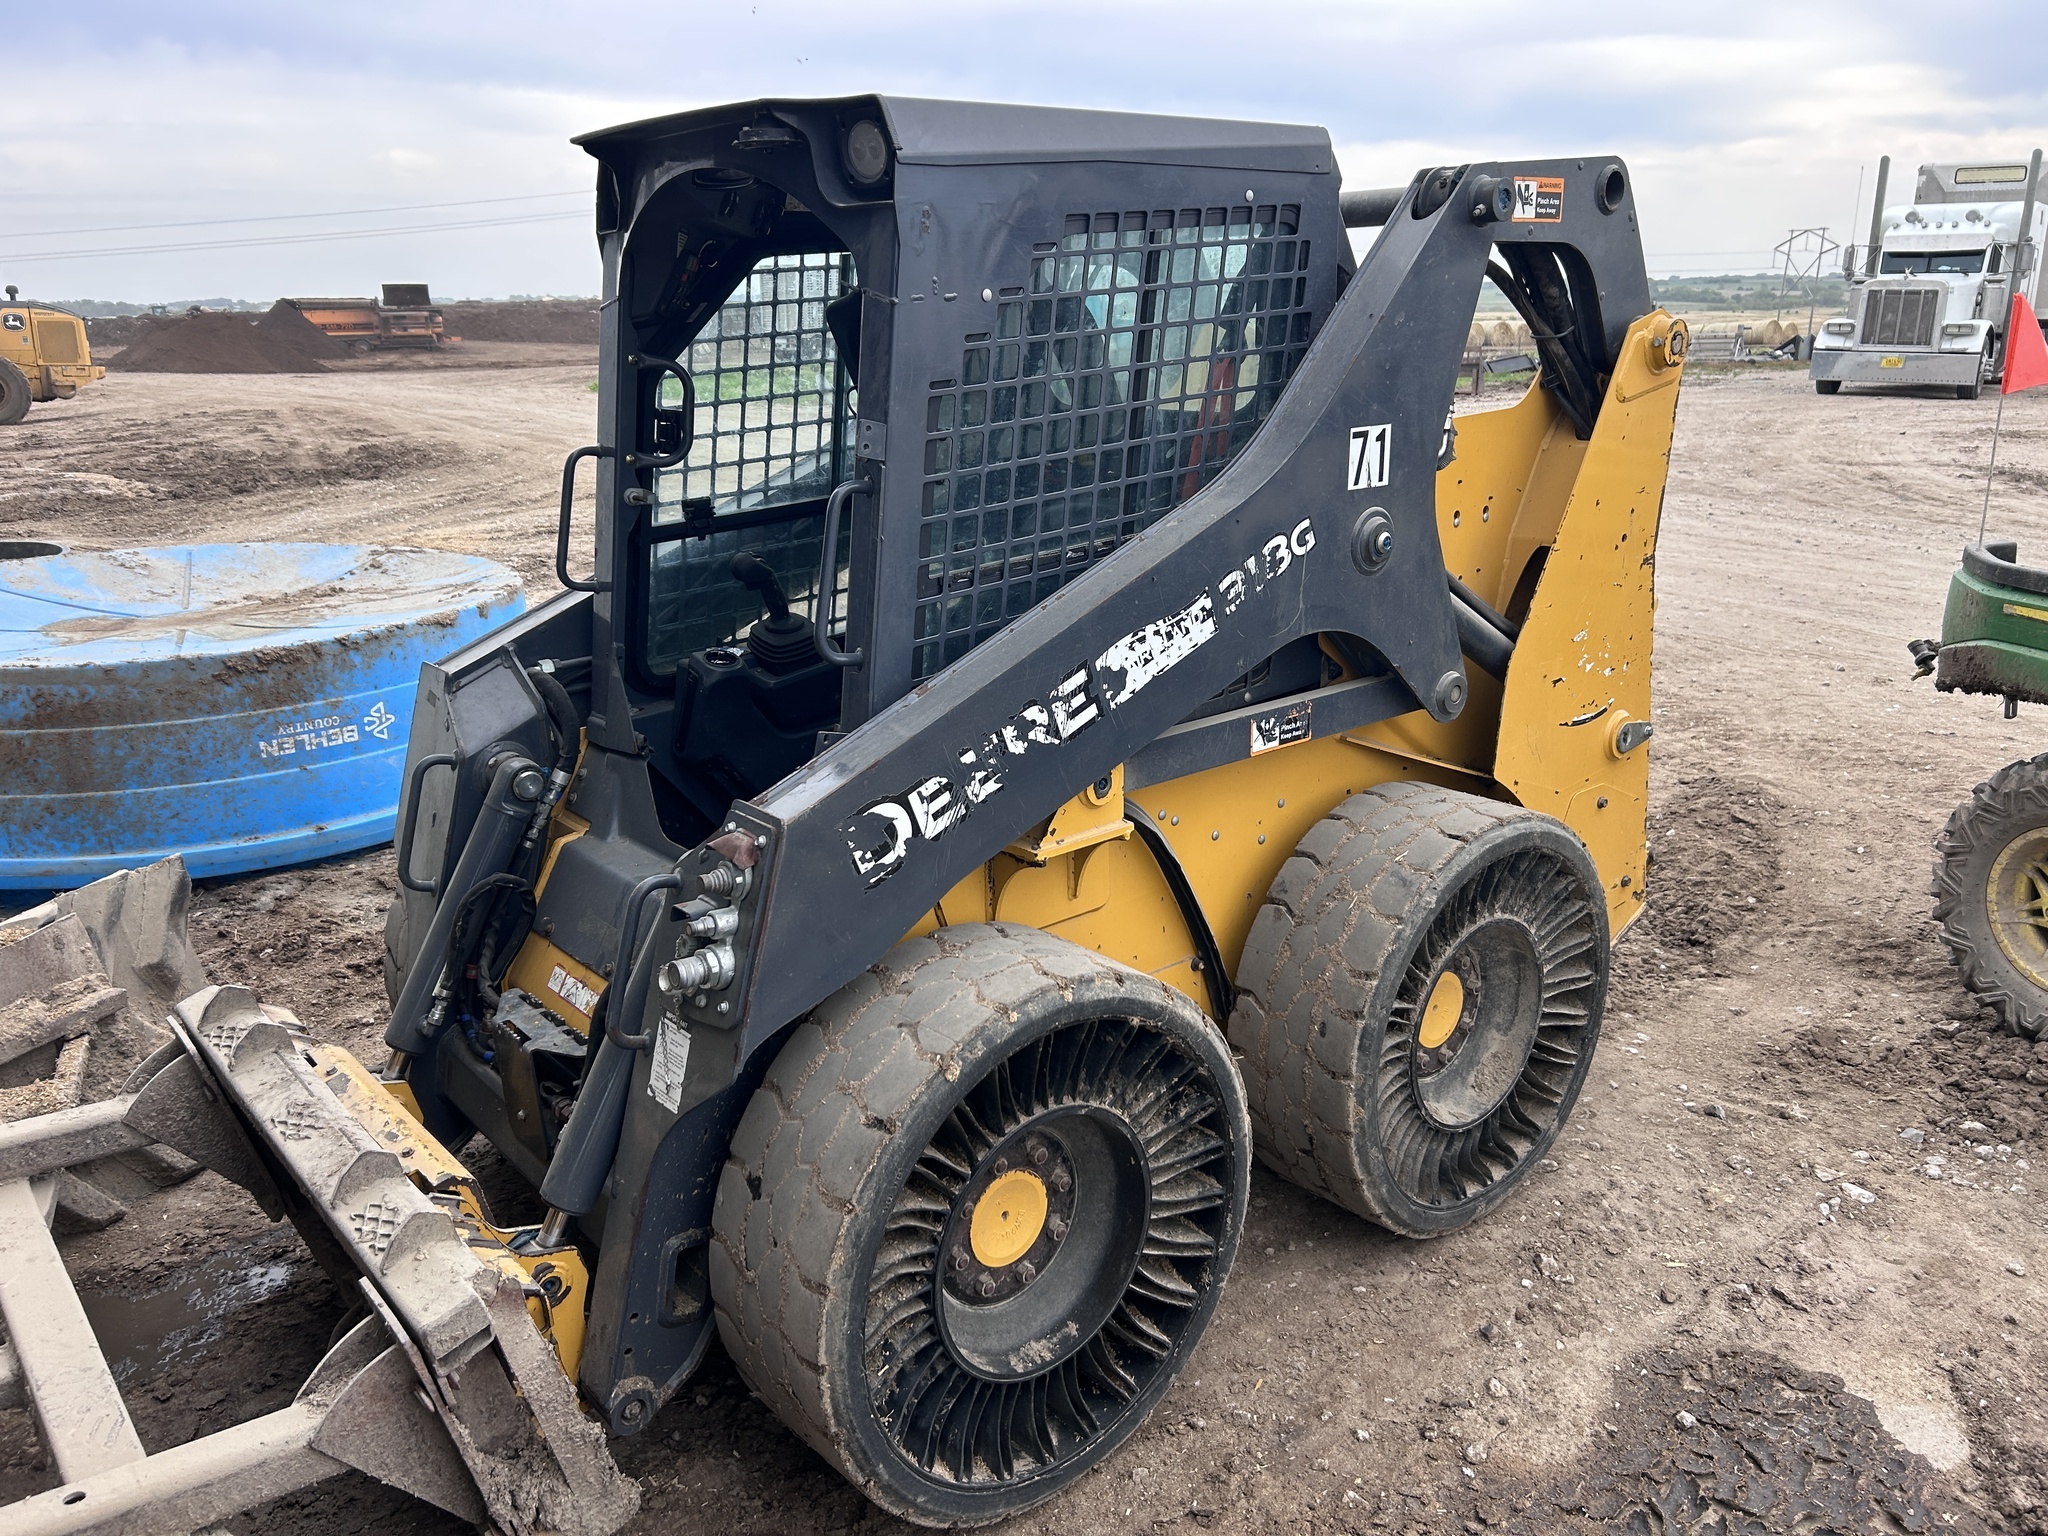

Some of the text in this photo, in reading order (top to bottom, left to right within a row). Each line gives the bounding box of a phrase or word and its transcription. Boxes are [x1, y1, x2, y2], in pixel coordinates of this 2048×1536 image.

[1537, 197, 1560, 205] Pinch Area
[1351, 427, 1387, 487] 71
[277, 715, 341, 736] COUNTRY
[1280, 722, 1295, 731] Pinch
[258, 724, 360, 759] BEHLEN
